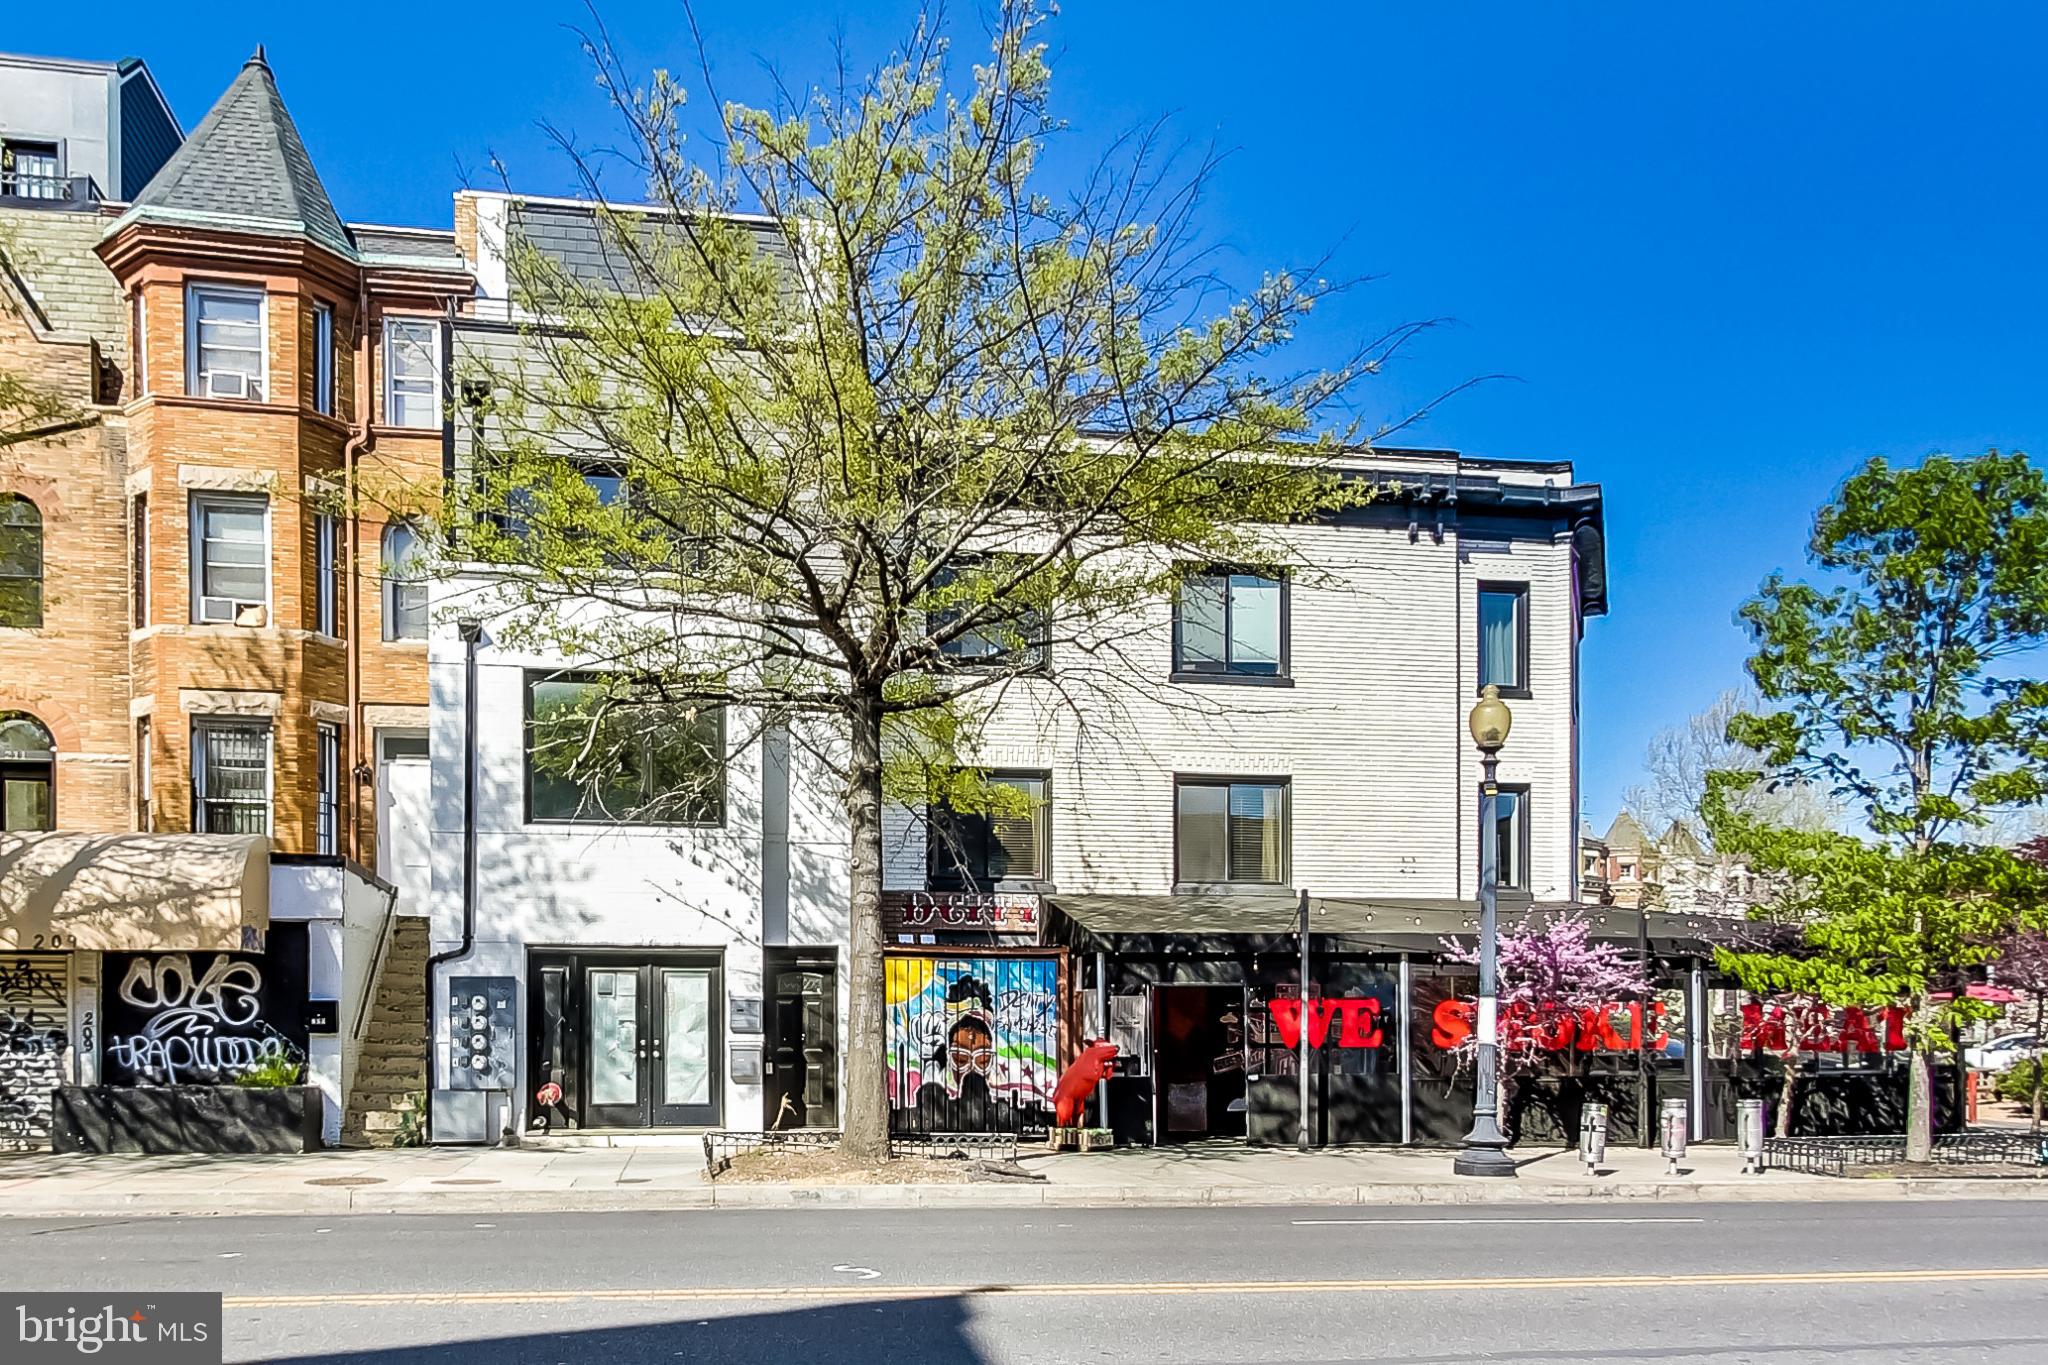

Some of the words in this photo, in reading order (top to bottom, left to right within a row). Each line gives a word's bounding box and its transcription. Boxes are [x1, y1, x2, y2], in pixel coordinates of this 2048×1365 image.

[33, 934, 77, 949] 209
[82, 1012, 94, 1052] 209
[1268, 998, 1383, 1049] WE
